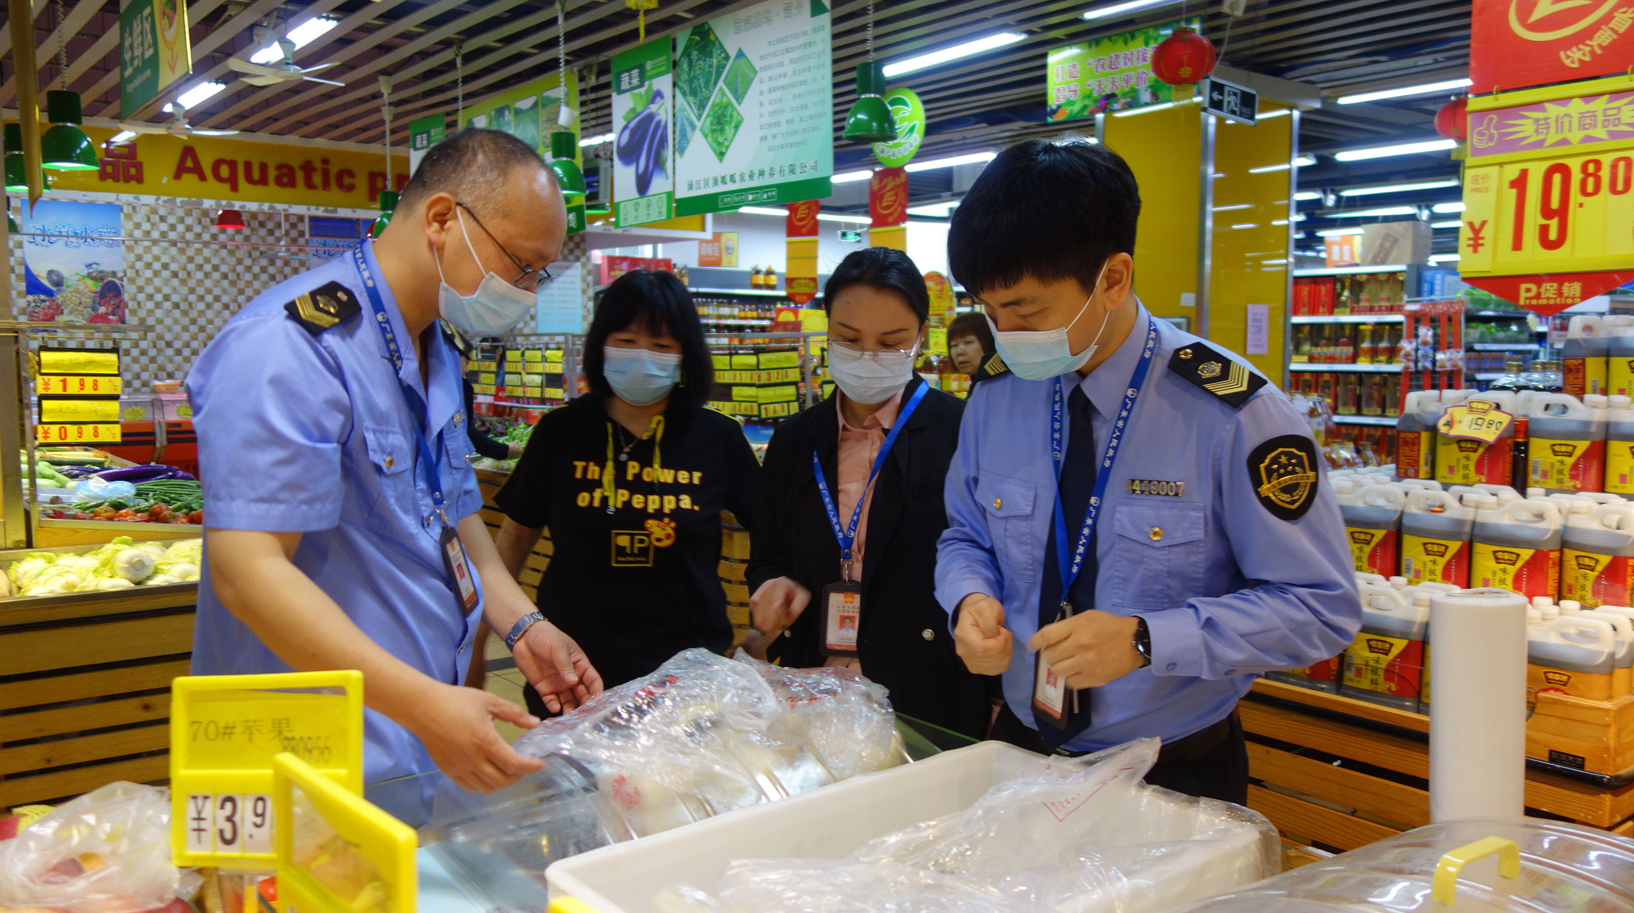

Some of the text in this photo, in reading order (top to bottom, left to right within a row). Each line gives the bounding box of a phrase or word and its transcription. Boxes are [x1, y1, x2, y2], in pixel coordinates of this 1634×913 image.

[1054, 45, 1157, 82] 打造“农超对接
[1532, 106, 1622, 137] 特价商品
[173, 145, 356, 193] Aquatic
[1470, 186, 1490, 194] PRICE
[1538, 281, 1582, 298] 促销
[626, 461, 703, 485] Power
[576, 487, 700, 514] of Peppa.
